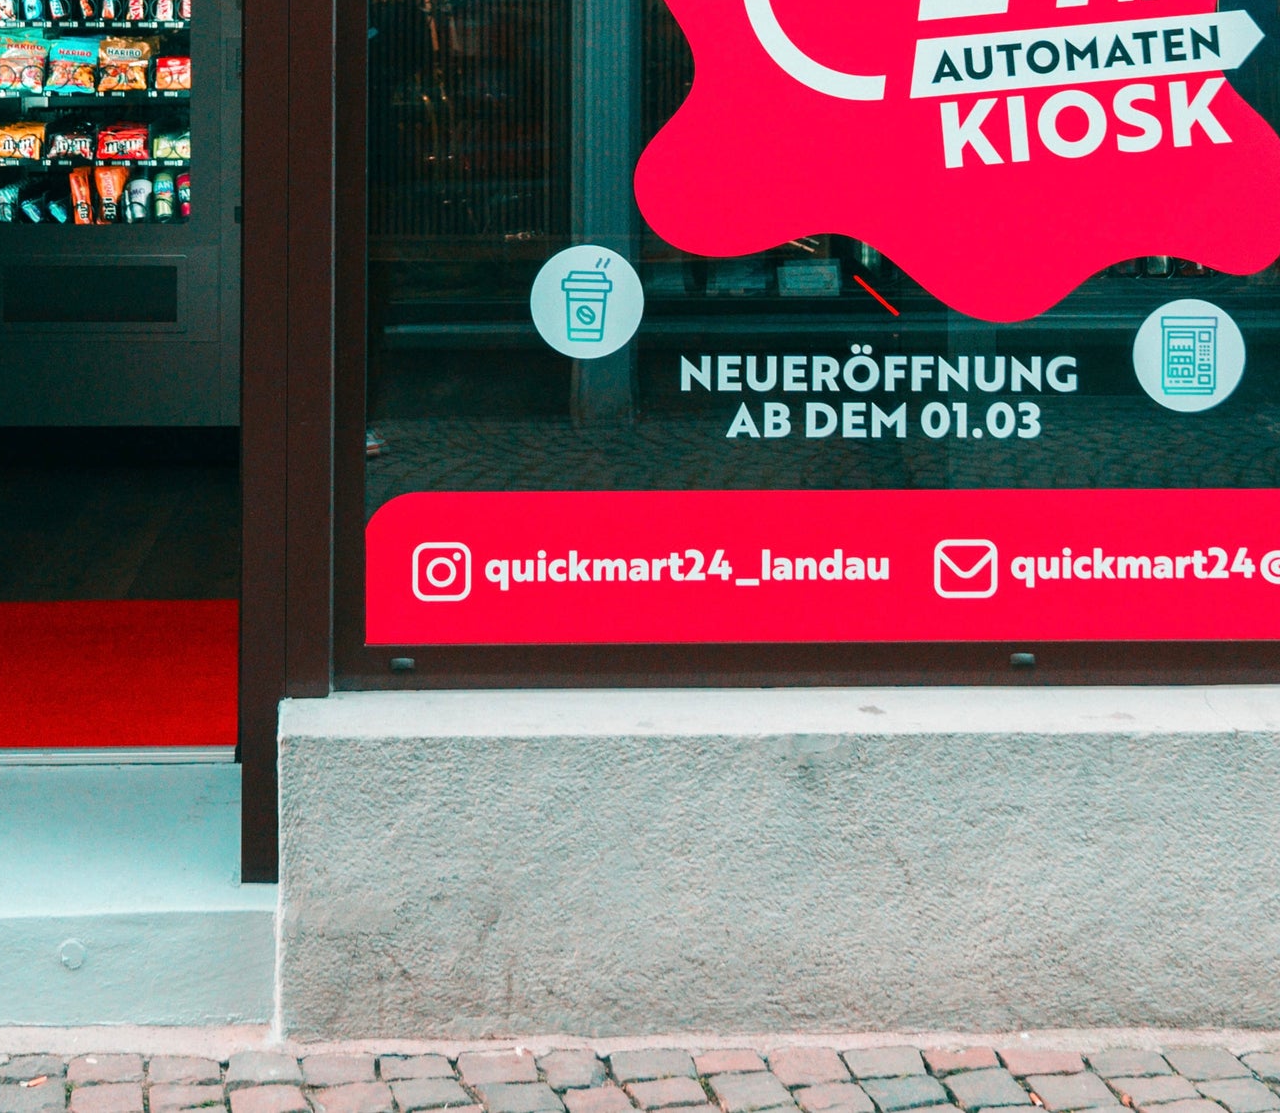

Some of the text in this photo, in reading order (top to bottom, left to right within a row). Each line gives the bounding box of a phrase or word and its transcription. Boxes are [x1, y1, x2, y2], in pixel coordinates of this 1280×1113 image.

[106, 47, 142, 58] HARIBO
[931, 24, 1221, 84] AUTOMATEN
[939, 77, 1233, 169] KIOSK
[680, 343, 1078, 393] NEUERÖFFNUNG
[725, 401, 1042, 439] AB DEM 01.03
[484, 548, 890, 591] quickmart24_landau
